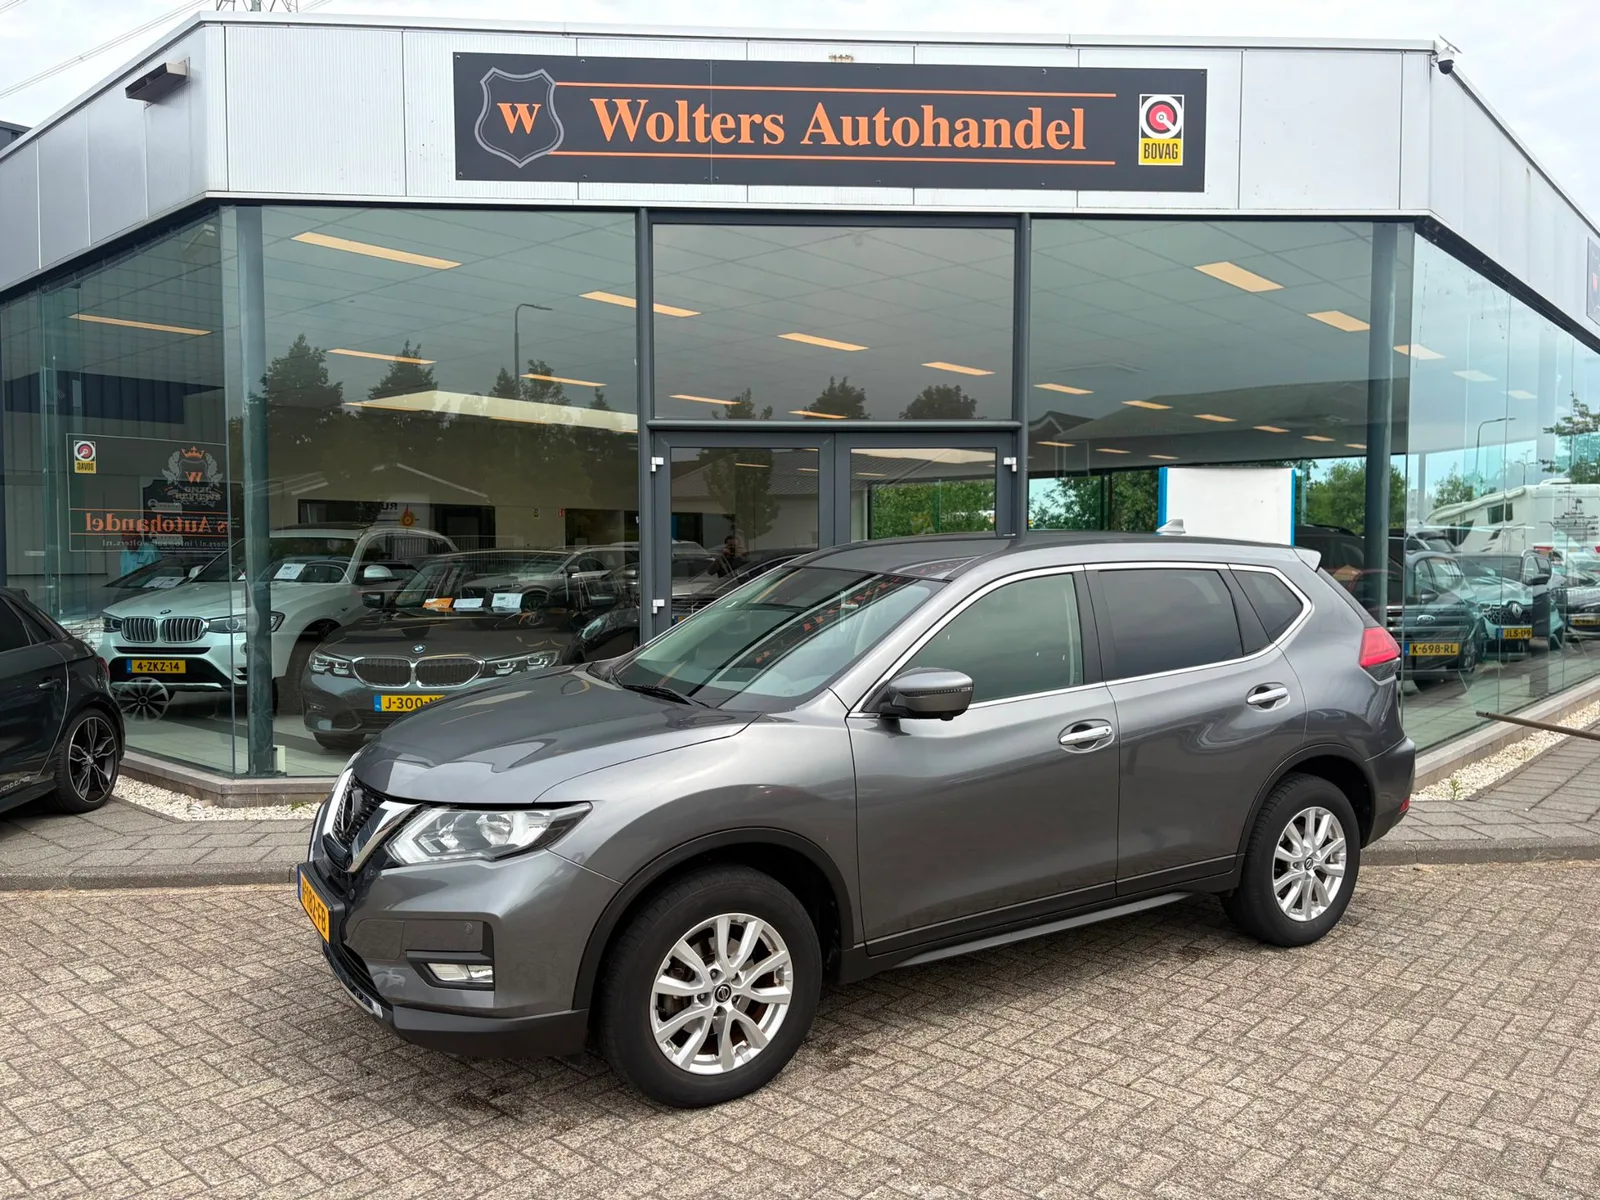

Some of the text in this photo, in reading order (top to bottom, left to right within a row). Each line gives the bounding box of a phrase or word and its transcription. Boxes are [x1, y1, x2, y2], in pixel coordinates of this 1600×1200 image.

[496, 102, 542, 134] W
[589, 98, 1087, 150] Wolters Autohandel
[1143, 142, 1179, 160] BOVAG
[1412, 644, 1456, 654] K-698-RL
[137, 662, 180, 671] 4-ZKZ-14
[385, 697, 439, 709] J-300-
